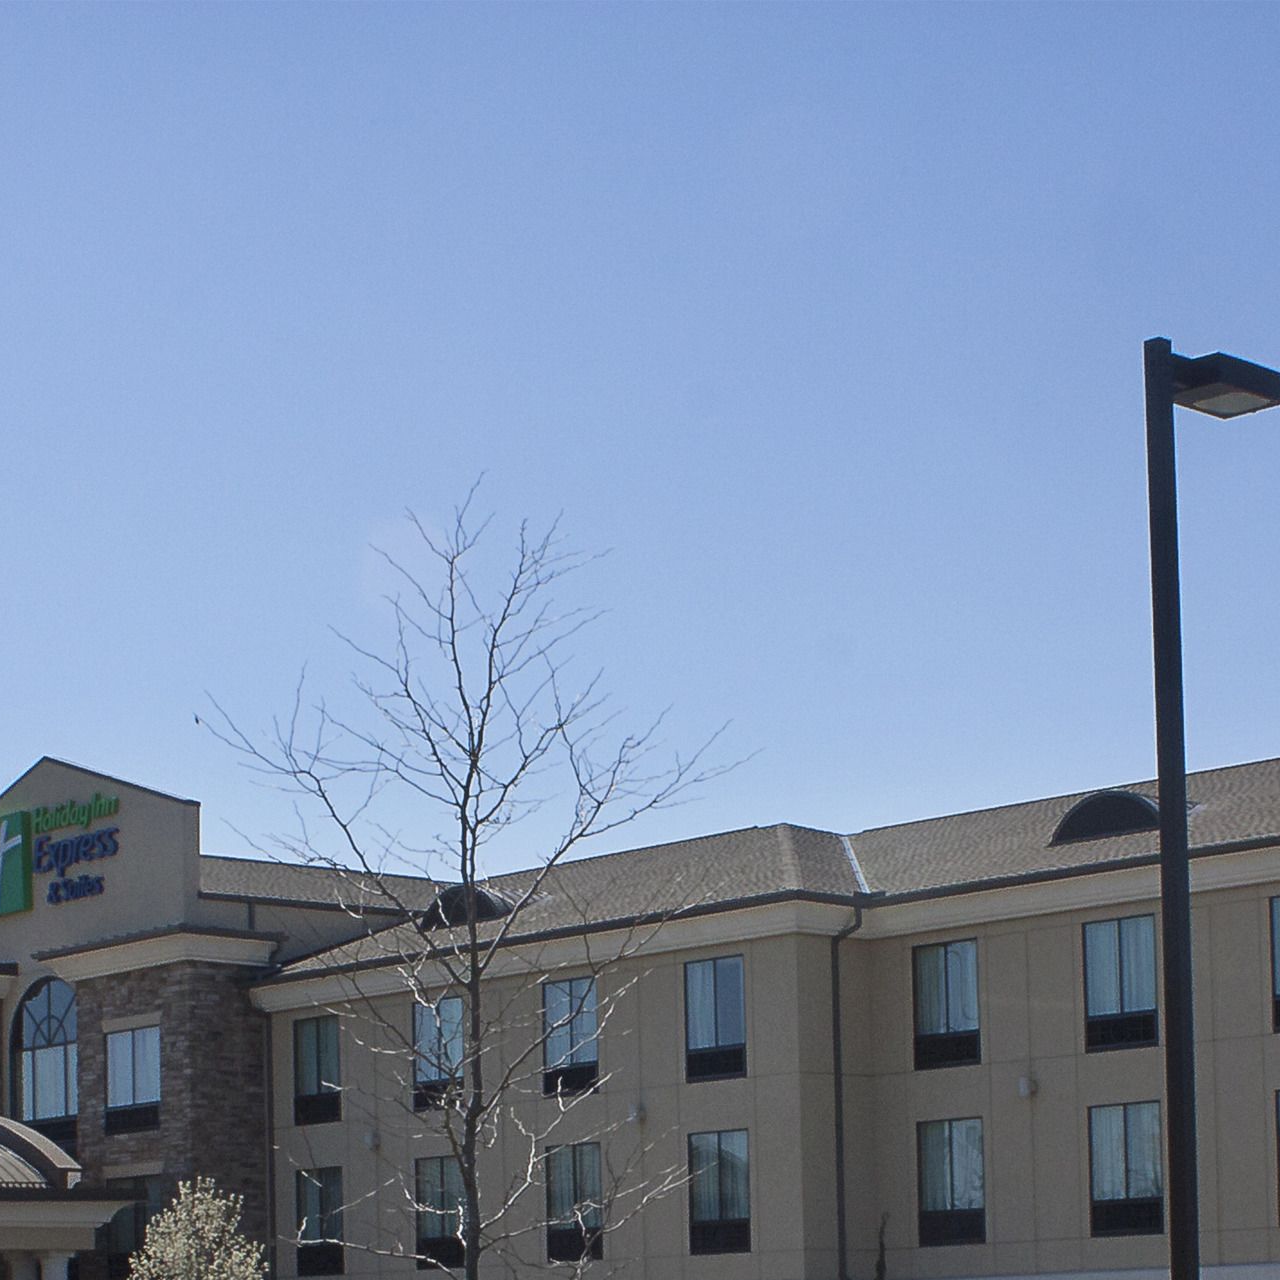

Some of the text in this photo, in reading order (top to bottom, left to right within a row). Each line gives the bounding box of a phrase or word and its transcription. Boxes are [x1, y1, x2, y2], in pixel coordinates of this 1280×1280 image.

[32, 792, 119, 834] Holiday Inn
[32, 826, 120, 878] Express
[46, 881, 62, 905] &
